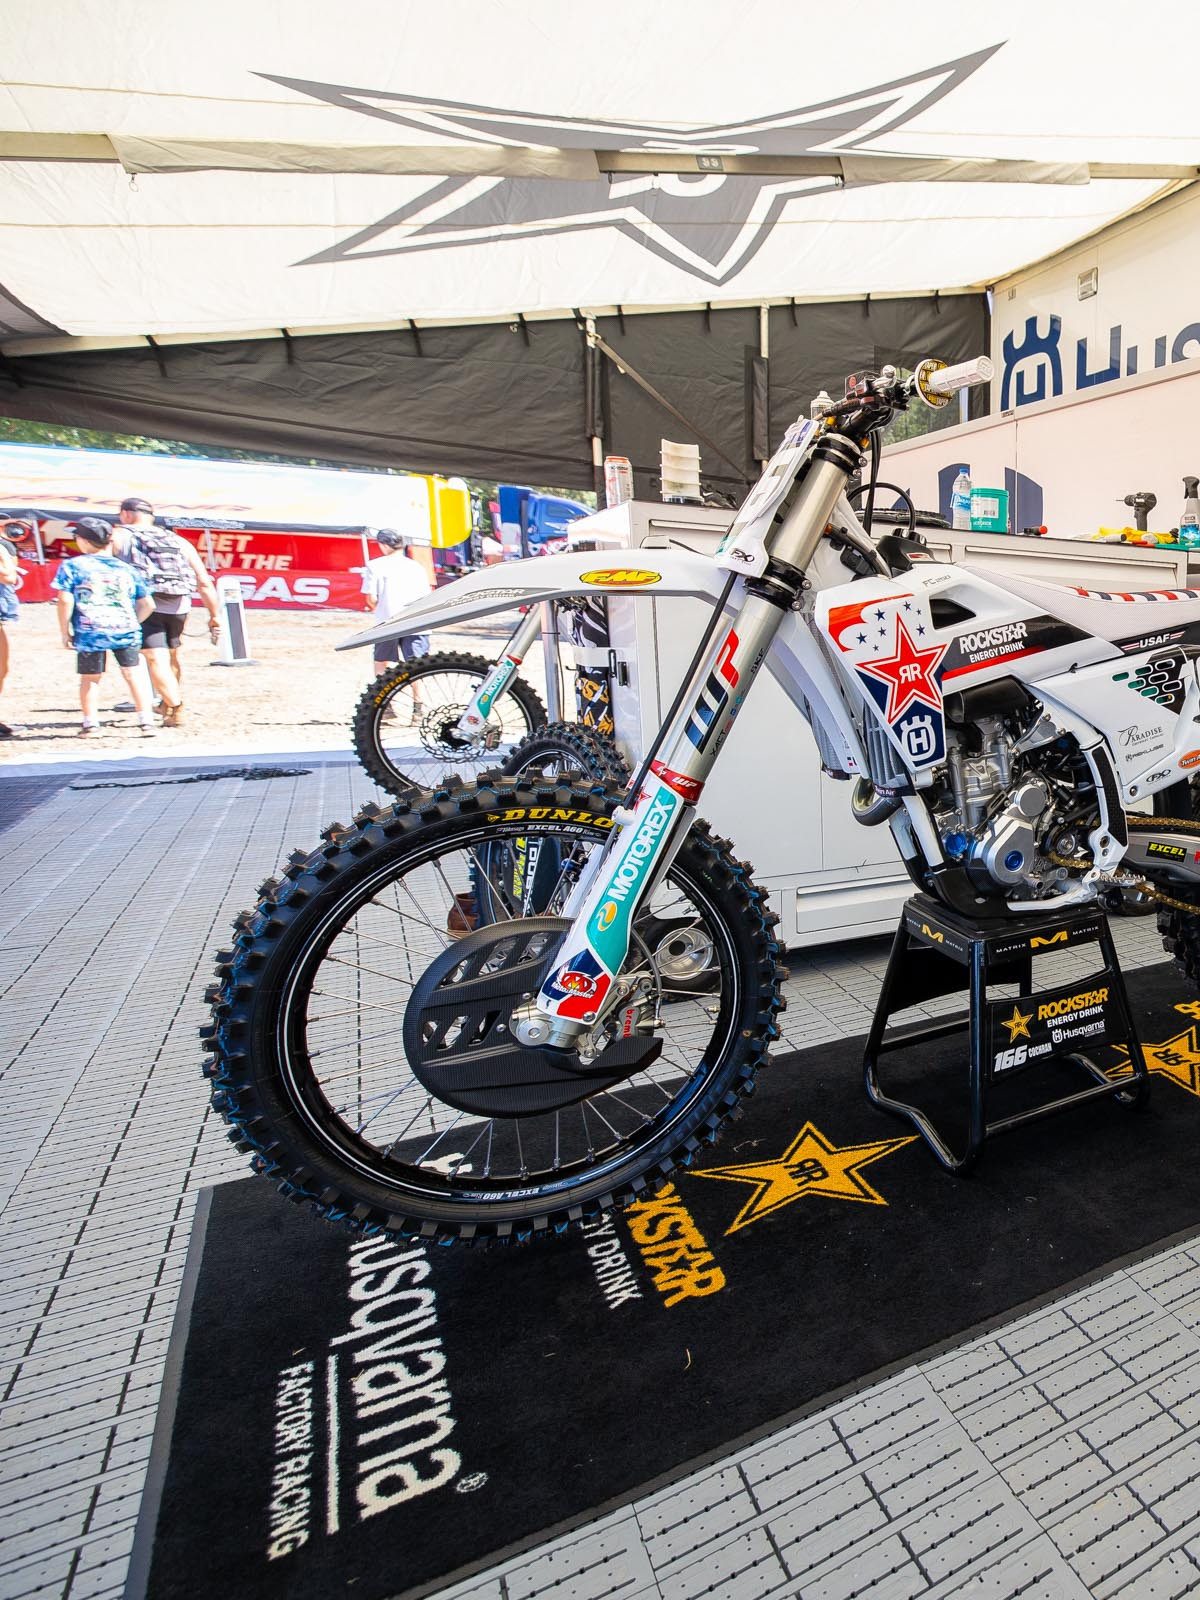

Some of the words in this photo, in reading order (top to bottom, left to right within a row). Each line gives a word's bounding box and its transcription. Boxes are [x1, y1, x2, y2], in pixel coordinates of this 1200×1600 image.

[197, 533, 254, 553] GET
[239, 553, 294, 571] THE
[590, 571, 660, 586] FMF
[959, 622, 1028, 654] ROCKSTAR
[1139, 633, 1170, 648] USAF
[969, 645, 998, 664] ENERGY
[998, 640, 1025, 657] DRINK
[1118, 725, 1163, 747] PARADISE
[502, 808, 624, 833] DUNLO
[527, 824, 562, 832] EXCEL
[608, 800, 675, 901] MOTOREX
[1149, 843, 1185, 857] EXCEL
[996, 943, 1027, 953] MATRIX
[1072, 926, 1099, 936] MATRIX
[1038, 987, 1109, 1021] ROCKSTAR
[1047, 1010, 1079, 1028] ENERGY
[1079, 1005, 1104, 1022] DRINK
[1063, 1020, 1105, 1040] Husqvarna
[994, 1045, 1028, 1073] 166
[1028, 1043, 1053, 1058] COCHRAN
[623, 1182, 726, 1308] KSTAR
[587, 1238, 644, 1309] DRINK
[330, 1234, 462, 1522] usqvarna
[273, 1360, 315, 1455] FACTORY
[266, 1451, 315, 1562] RACING
